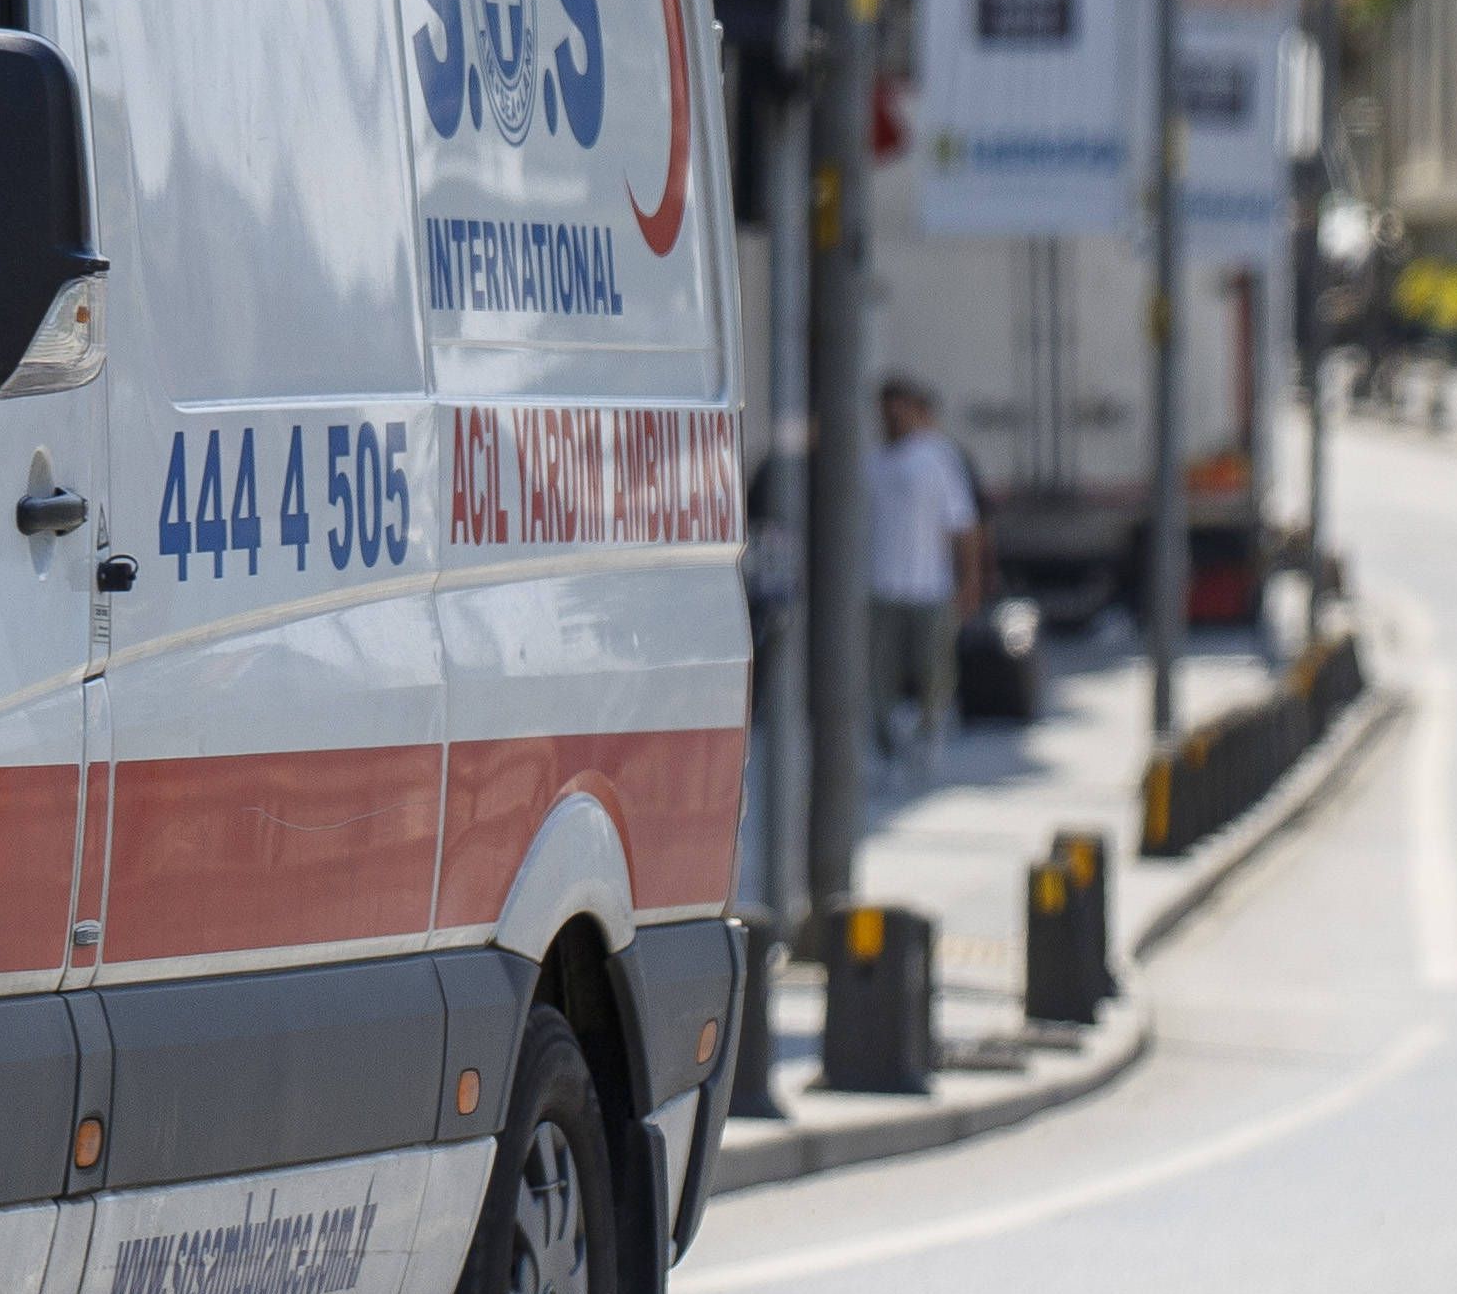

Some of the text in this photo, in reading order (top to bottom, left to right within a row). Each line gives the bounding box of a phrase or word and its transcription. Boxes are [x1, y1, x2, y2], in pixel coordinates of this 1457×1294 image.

[426, 217, 623, 315] INTERNATIONAL
[159, 421, 410, 581] 444 4 505
[512, 408, 605, 543] YARDIM
[613, 410, 736, 543] AMBULANSI
